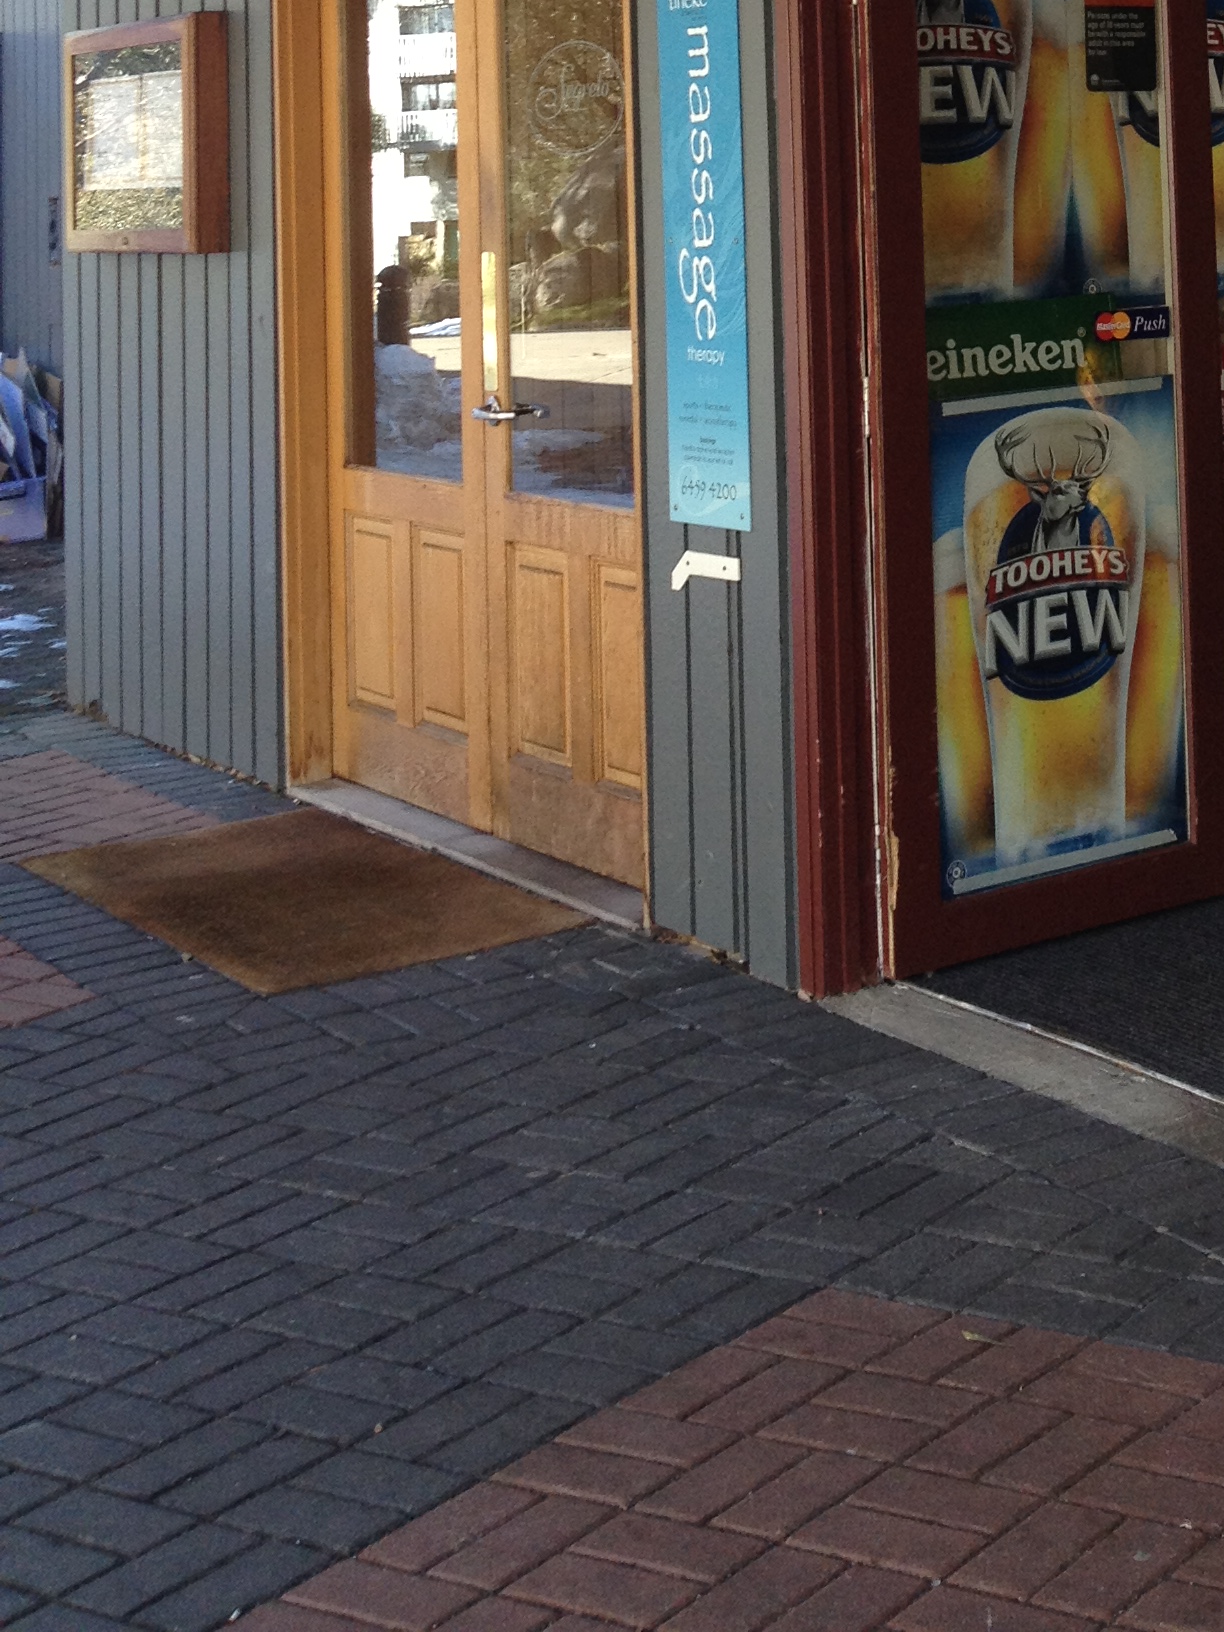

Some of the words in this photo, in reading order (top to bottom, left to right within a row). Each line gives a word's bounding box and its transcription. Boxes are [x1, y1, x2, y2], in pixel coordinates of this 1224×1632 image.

[679, 24, 717, 341] massage
[1133, 314, 1167, 333] Push
[687, 345, 725, 367] therapy
[709, 481, 737, 501] 4200
[990, 549, 1126, 595] TOOHEYS
[984, 588, 1130, 678] NEW
